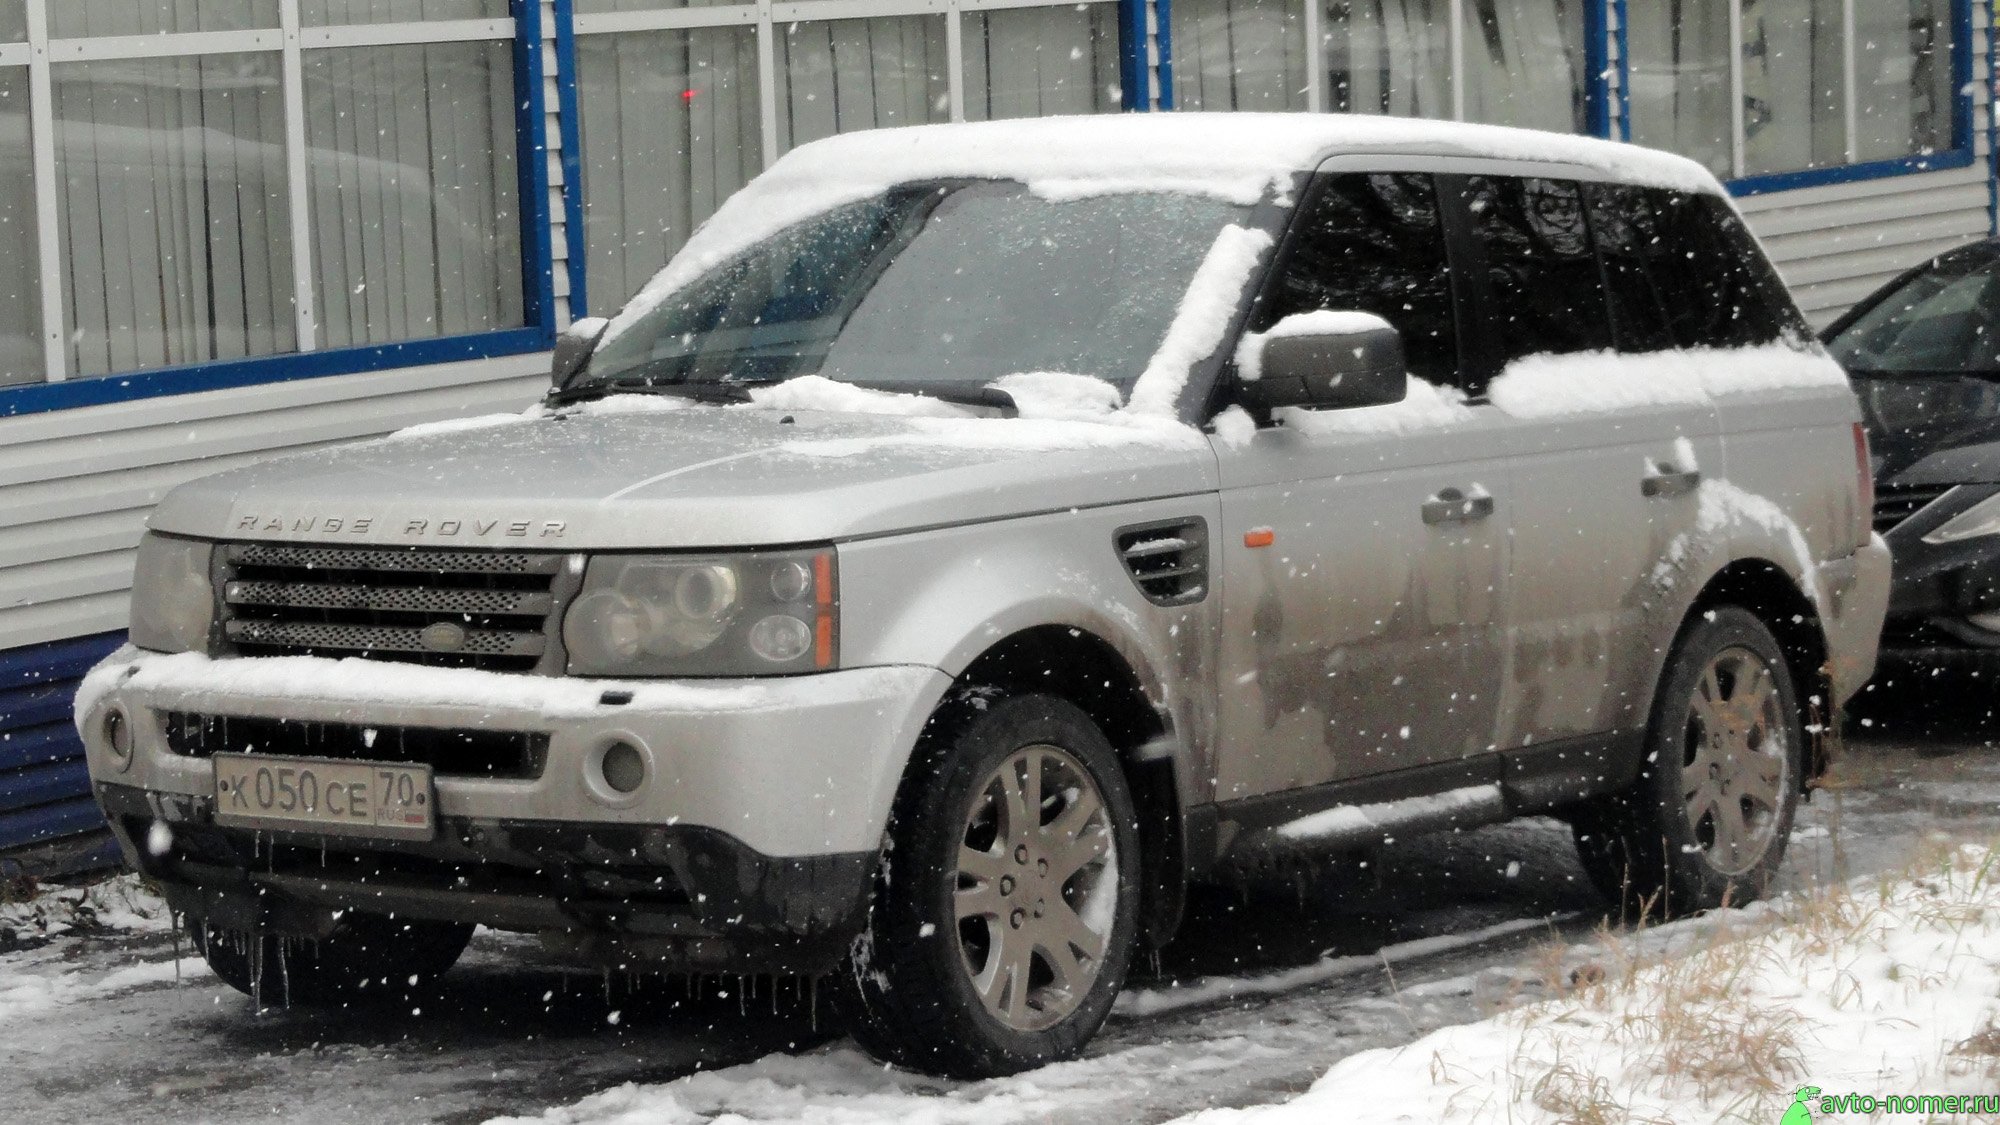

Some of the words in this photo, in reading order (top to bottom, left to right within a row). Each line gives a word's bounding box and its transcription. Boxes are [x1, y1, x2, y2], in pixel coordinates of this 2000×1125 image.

[237, 515, 373, 534] RANGE
[403, 519, 567, 538] ROVER
[379, 771, 414, 807] 70
